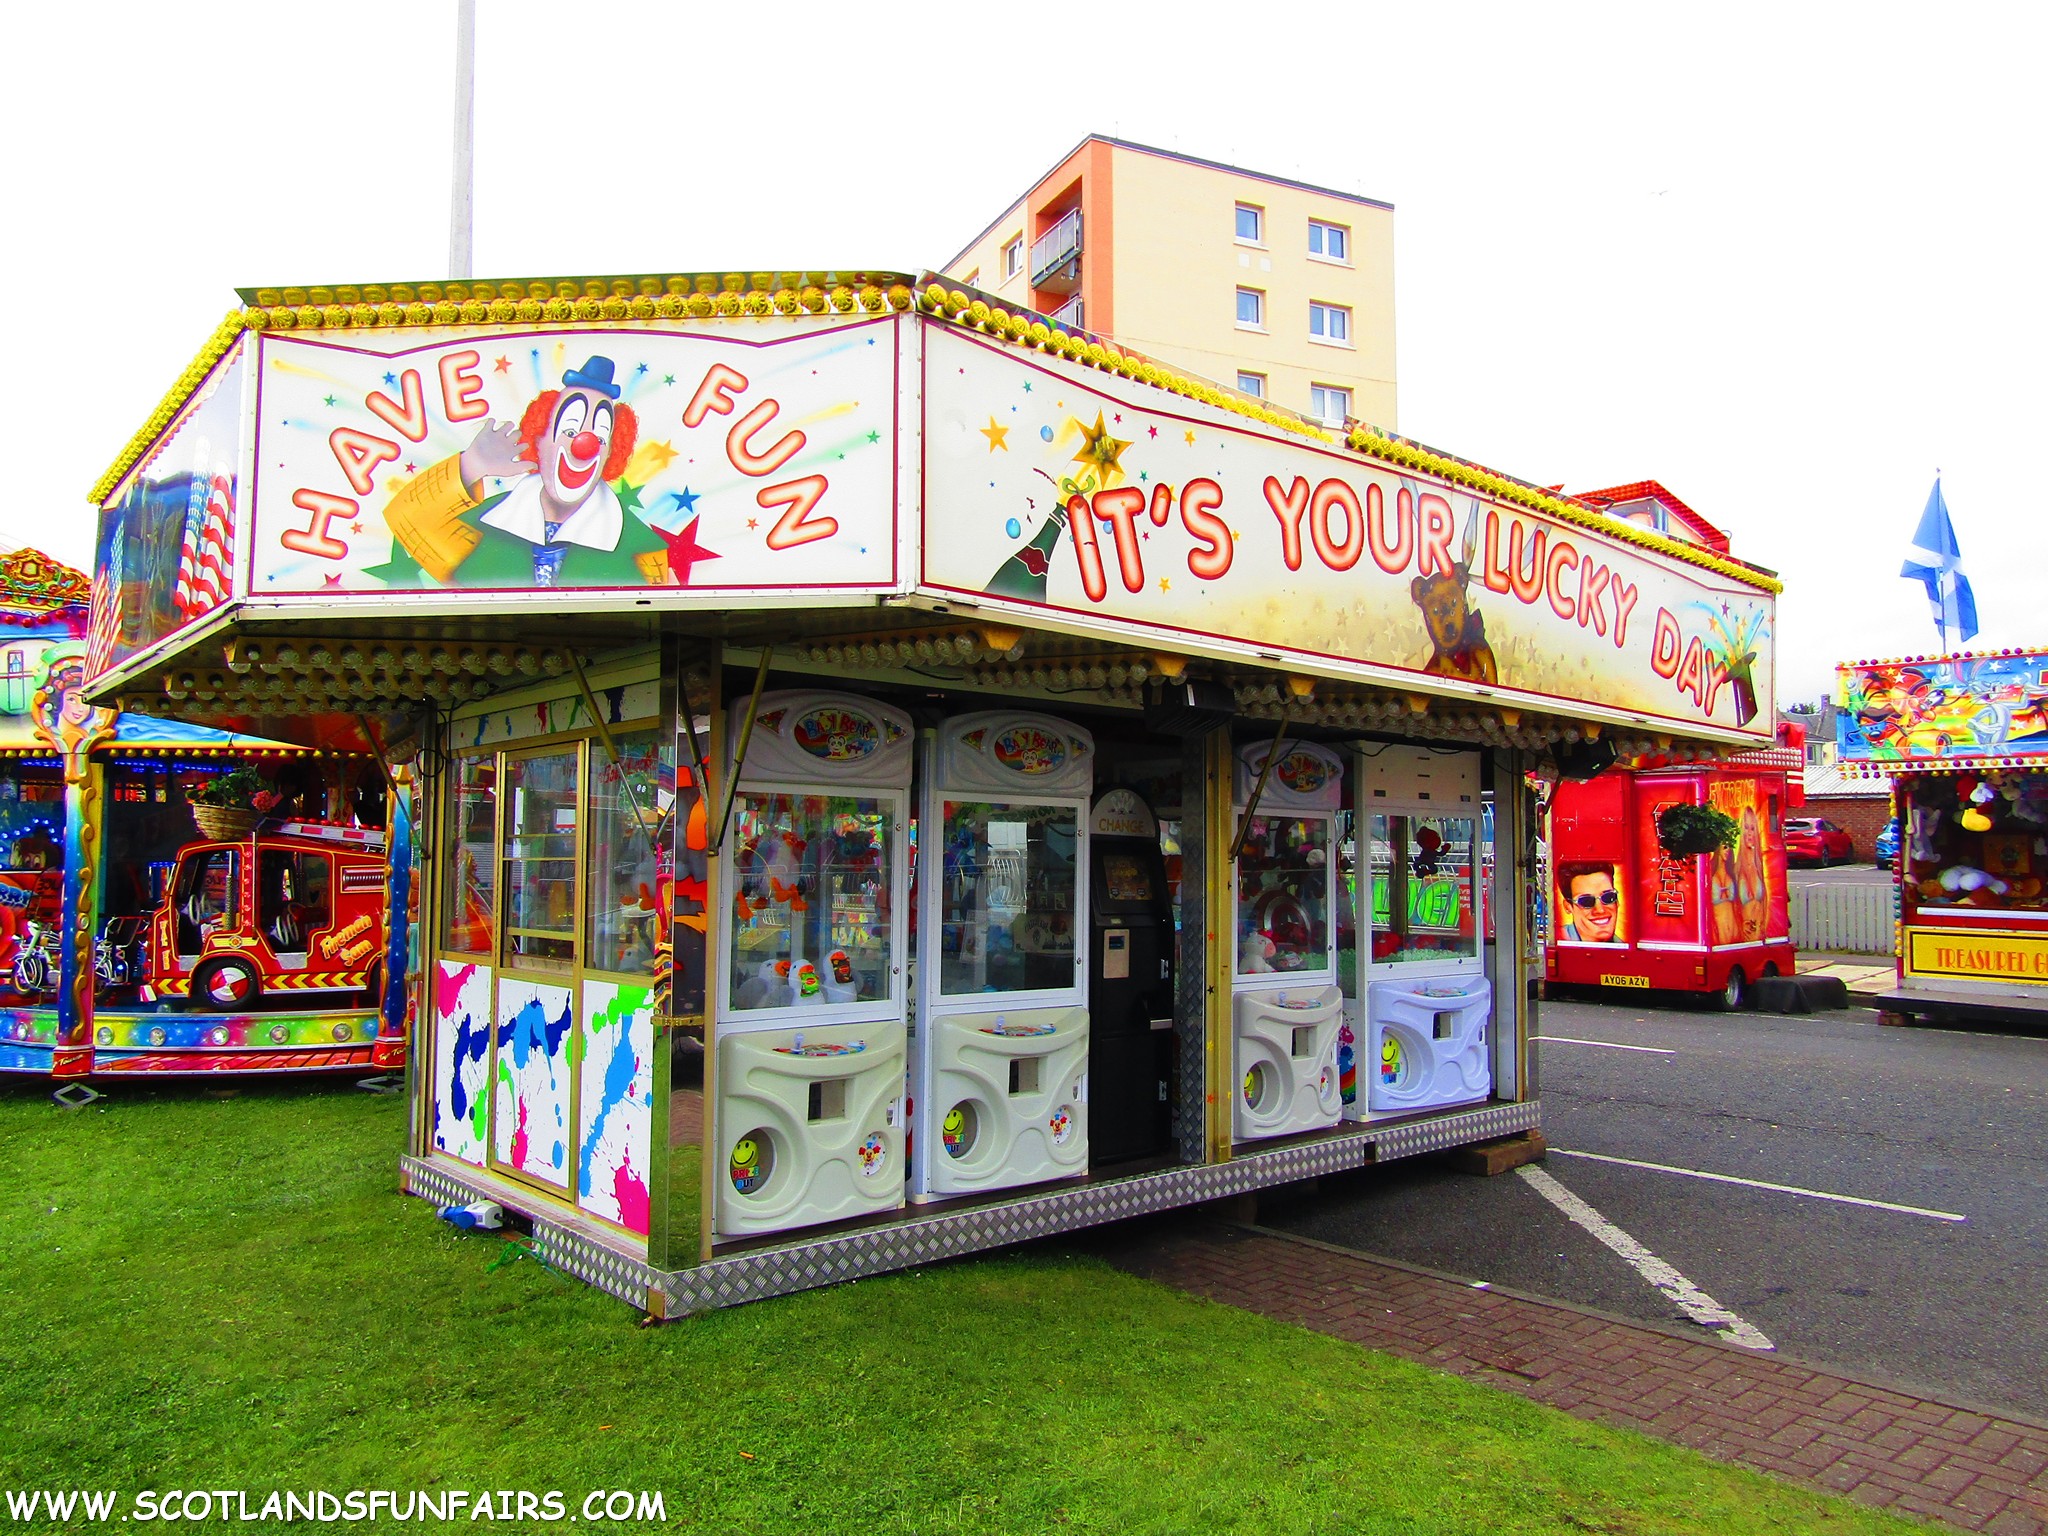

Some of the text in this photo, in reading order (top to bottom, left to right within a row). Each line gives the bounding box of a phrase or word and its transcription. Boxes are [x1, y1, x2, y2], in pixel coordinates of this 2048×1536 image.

[282, 349, 840, 561] HAVE FUN
[1067, 474, 1727, 718] IT'S YOUR LUCKY DAY
[1098, 818, 1145, 834] CHANGE
[1652, 801, 1685, 916] AALINE
[320, 914, 372, 960] Fireman
[340, 939, 373, 967] Sam
[1935, 947, 2028, 972] TREASURED
[1604, 975, 1646, 986] AY06 AZV
[732, 1165, 760, 1180] PRIZE
[735, 1179, 754, 1190] OUT
